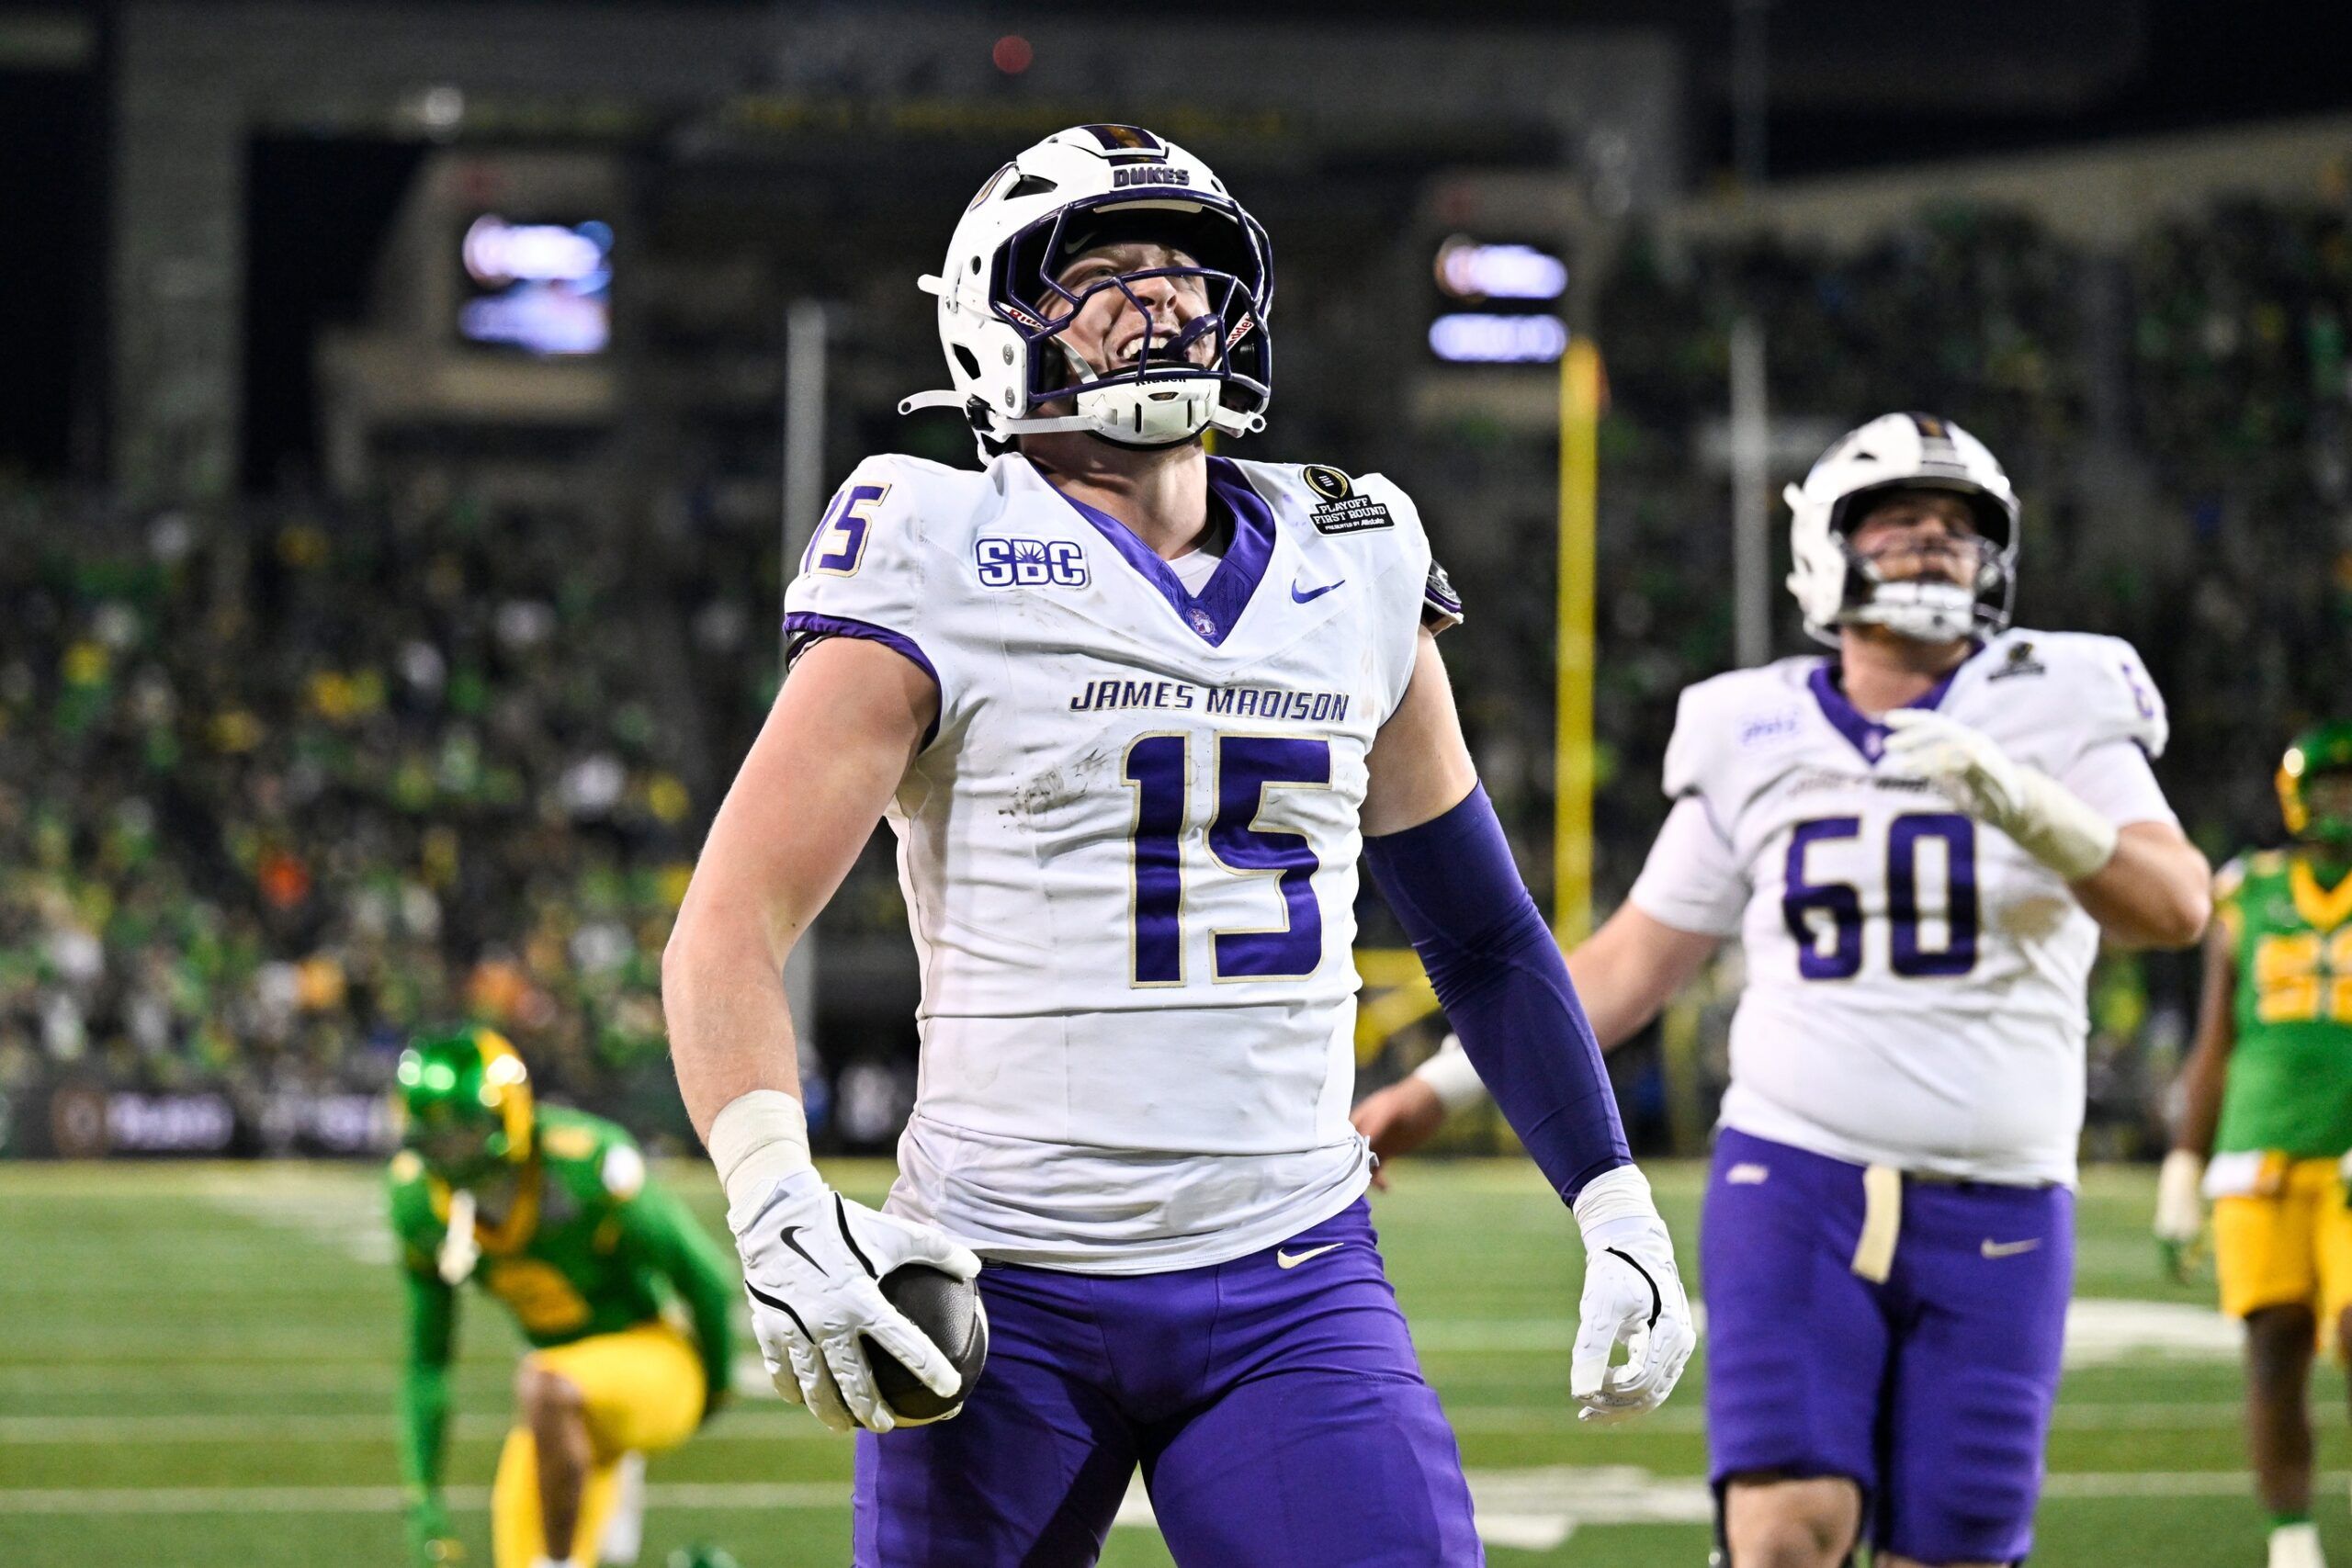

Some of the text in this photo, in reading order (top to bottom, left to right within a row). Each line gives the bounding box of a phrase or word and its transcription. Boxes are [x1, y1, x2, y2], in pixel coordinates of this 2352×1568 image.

[1114, 166, 1190, 187] DUKES
[1313, 505, 1386, 525] FIRST ROUND
[1318, 497, 1368, 514] PLAYOFF
[976, 538, 1086, 587] SBC
[1069, 679, 1350, 723] JAMES MADISON
[1120, 729, 1333, 989] 15
[1781, 811, 1982, 981] 60
